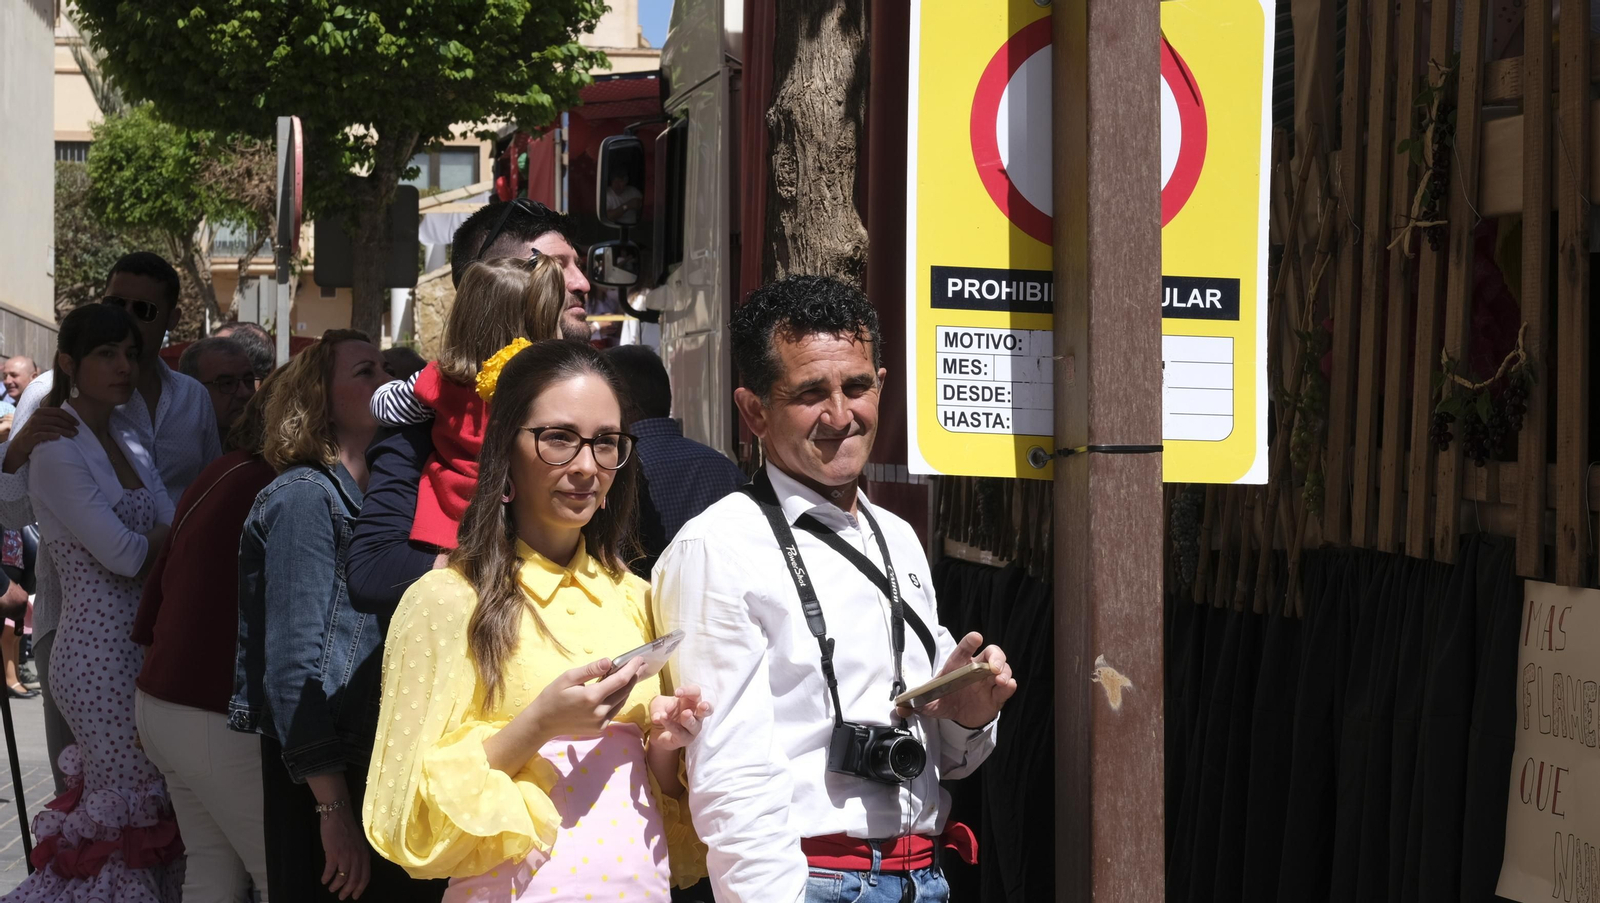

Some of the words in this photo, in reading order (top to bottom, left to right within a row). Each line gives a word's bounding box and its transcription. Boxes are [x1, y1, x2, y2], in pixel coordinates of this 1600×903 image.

[948, 278, 1053, 301] PROHIBI
[944, 331, 1022, 351] MOTIVO:
[943, 358, 987, 375] MES:
[943, 384, 1011, 403] DESDE:
[943, 410, 1010, 429] HASTA:
[785, 544, 807, 587] PowerShot
[887, 564, 899, 603] Canon
[1524, 600, 1572, 652] MAS
[1523, 662, 1600, 749] FLAME
[894, 727, 911, 736] Canon
[1519, 757, 1569, 819] QUE
